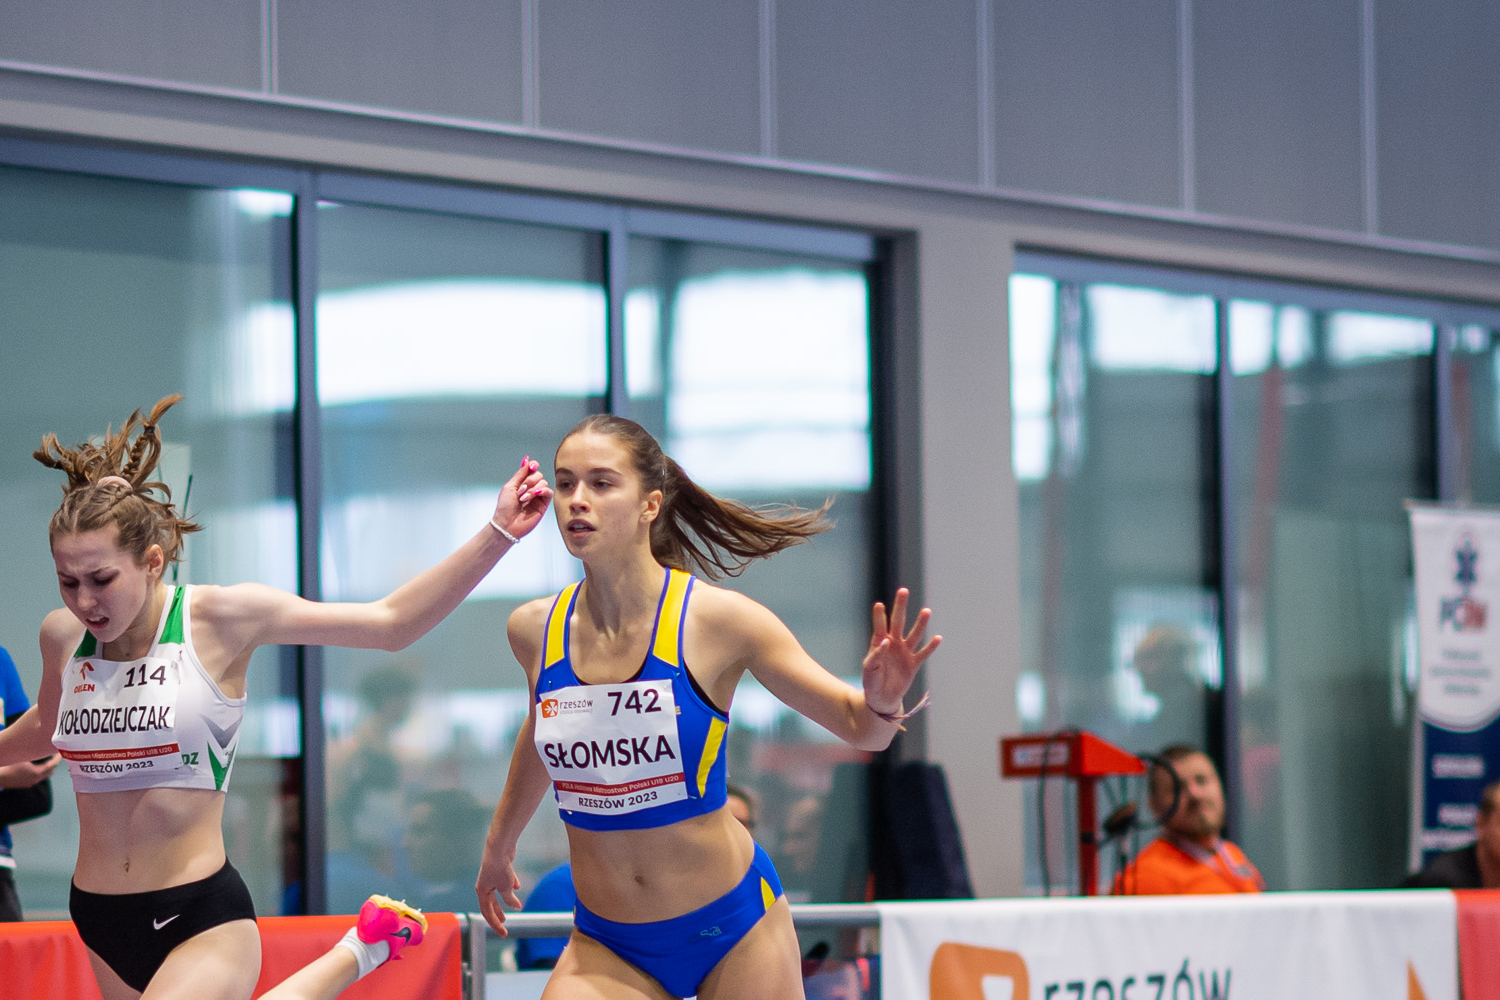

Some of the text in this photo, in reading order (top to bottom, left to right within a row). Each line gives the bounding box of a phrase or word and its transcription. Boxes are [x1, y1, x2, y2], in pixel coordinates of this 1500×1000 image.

[124, 664, 167, 688] 114
[608, 688, 662, 716] 742
[57, 705, 171, 736] KOŁODZIEJCZAK
[127, 750, 146, 758] Polski
[544, 735, 676, 769] SŁOMSKA
[79, 760, 154, 773] RZESZÓW 2023
[629, 781, 650, 791] Polski
[665, 775, 679, 783] U20
[578, 791, 658, 809] RZESZÓW 2023
